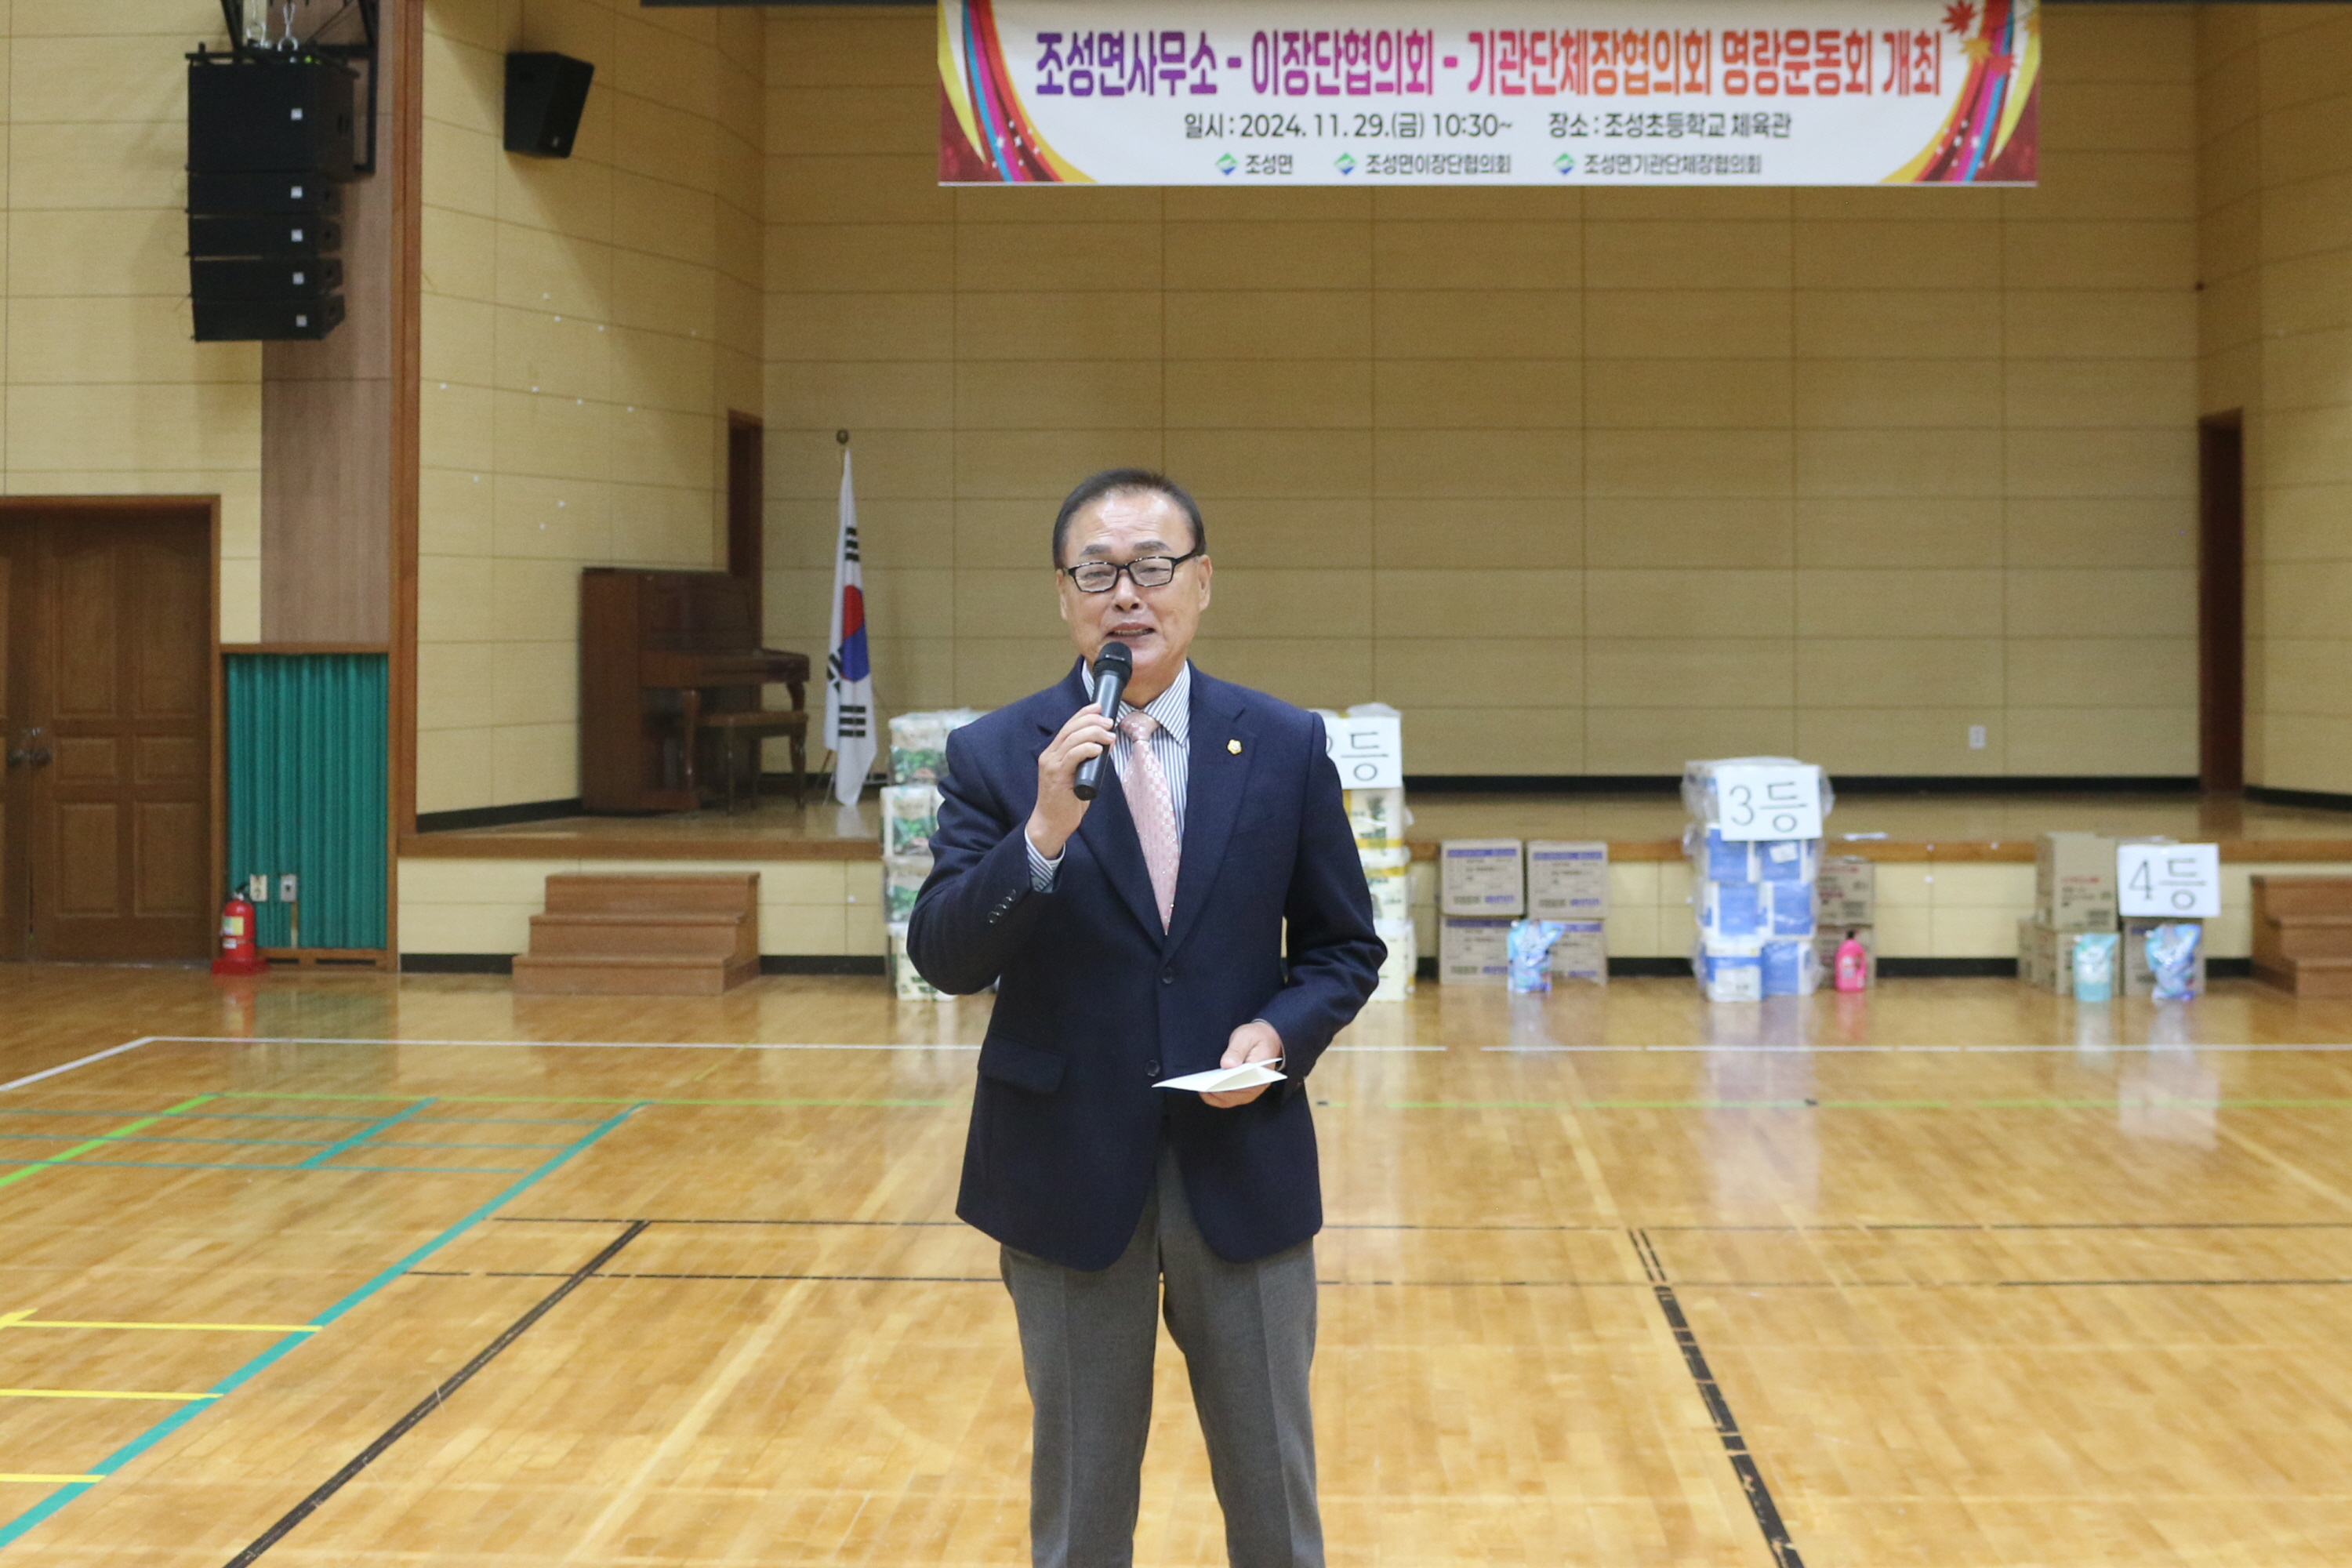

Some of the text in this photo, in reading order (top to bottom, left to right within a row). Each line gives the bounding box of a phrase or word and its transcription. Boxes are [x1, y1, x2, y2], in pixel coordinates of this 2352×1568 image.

[1036, 31, 1218, 96] 조성면사무소
[1251, 29, 1434, 96] 이장단협의회
[1468, 28, 1712, 96] 기관단체장협의회
[1722, 28, 1873, 96] 명랑운동회
[1882, 29, 1942, 96] 개최
[1731, 112, 1792, 139] 체육관
[1245, 154, 1293, 176] 조성면
[1367, 154, 1512, 176] 조성면이장단협의회
[1584, 154, 1762, 176] 조성면기관단체장협의회
[1730, 781, 1808, 833] 3등
[2128, 857, 2208, 911] 4등
